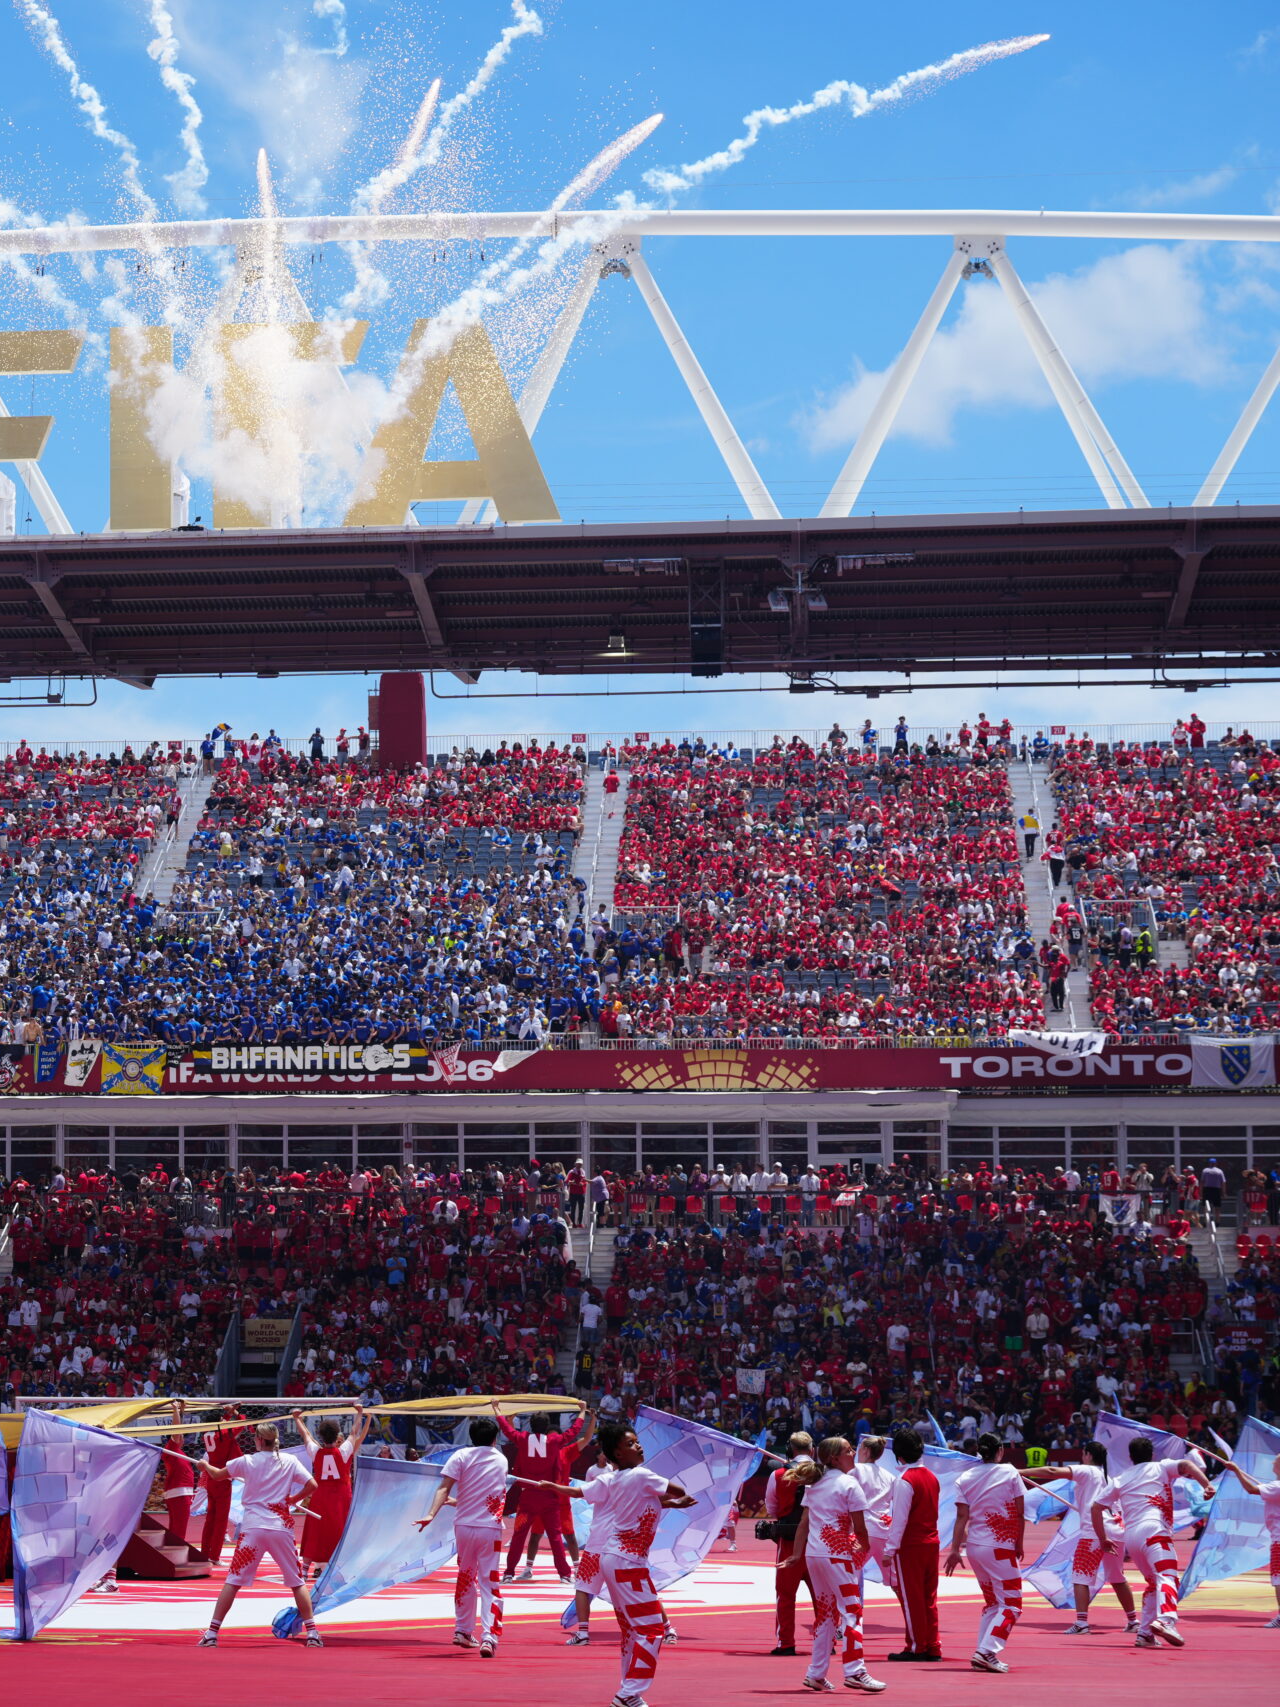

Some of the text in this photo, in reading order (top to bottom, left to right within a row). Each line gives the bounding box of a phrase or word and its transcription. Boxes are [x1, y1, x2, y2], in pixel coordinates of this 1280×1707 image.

[211, 1044, 410, 1070] BHFANATICS
[940, 1053, 1192, 1078] TORONTO
[631, 1194, 643, 1203] 116
[582, 1357, 591, 1369] 10
[528, 1434, 547, 1458] N
[321, 1454, 340, 1480] A
[615, 1568, 664, 1679] FIFA
